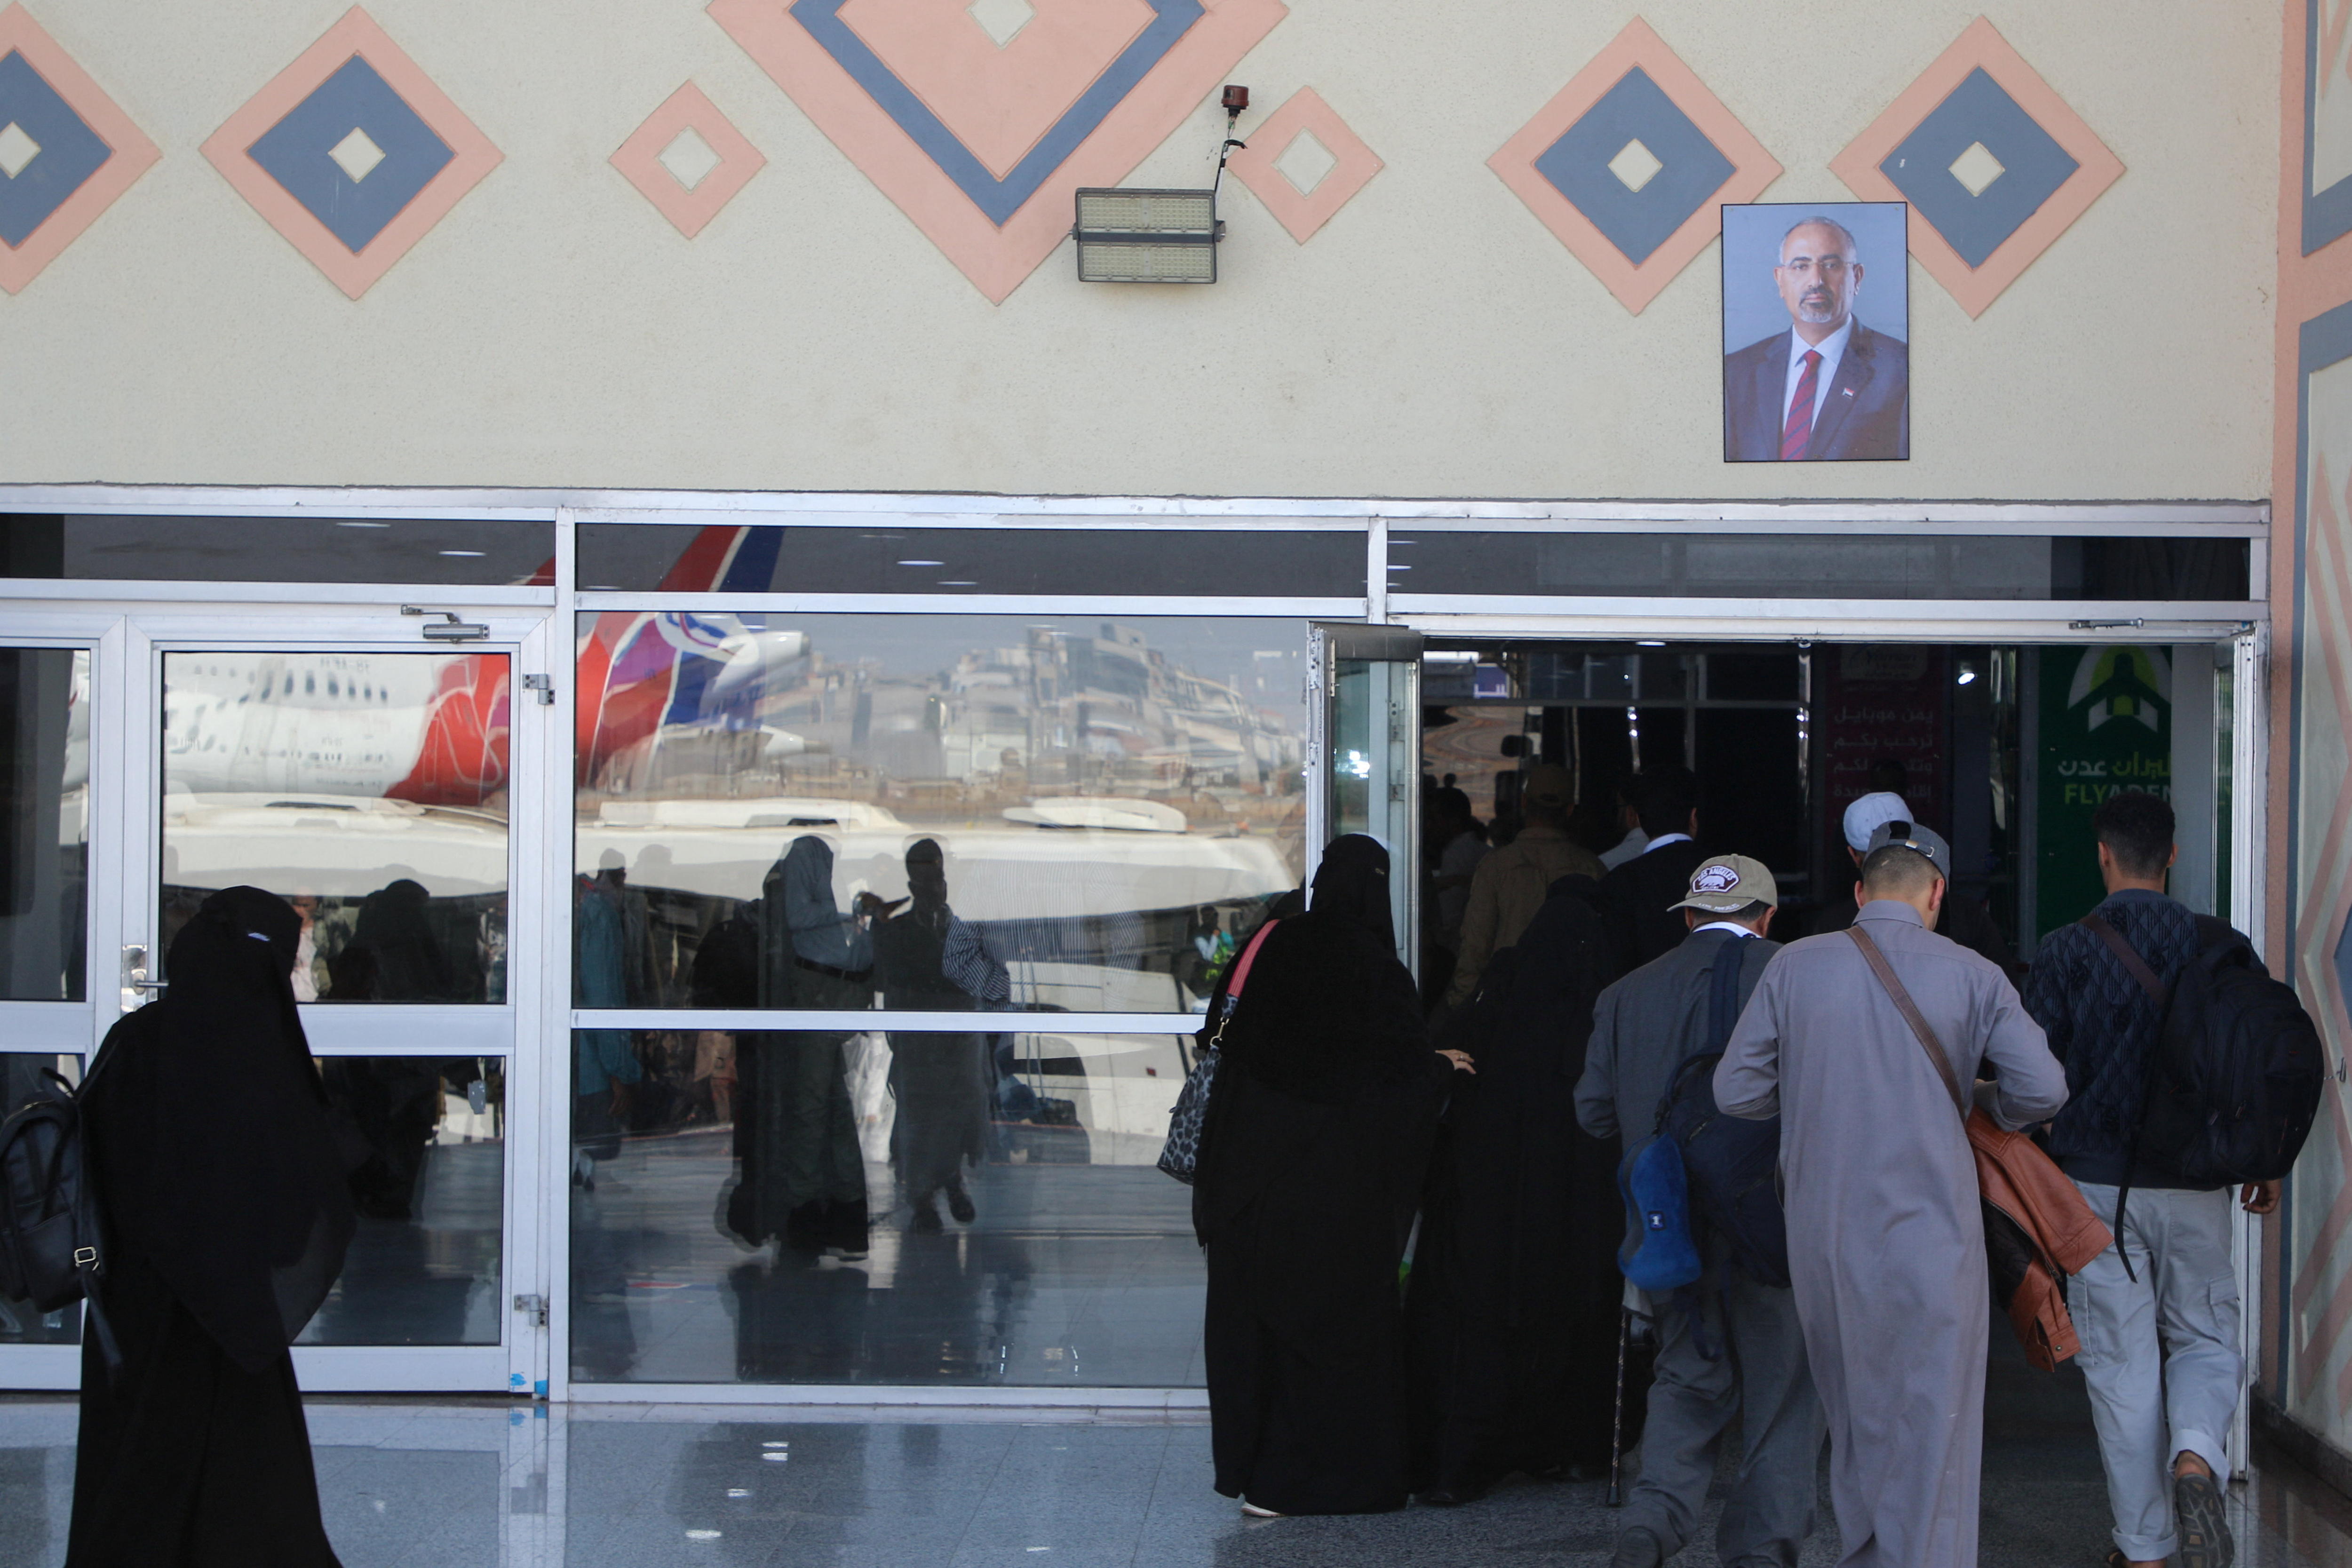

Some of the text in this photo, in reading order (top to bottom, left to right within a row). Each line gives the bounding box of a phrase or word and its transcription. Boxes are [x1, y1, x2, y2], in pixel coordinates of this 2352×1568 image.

[2058, 751, 2171, 779] يران عدن
[1708, 867, 1734, 881] ANGELES
